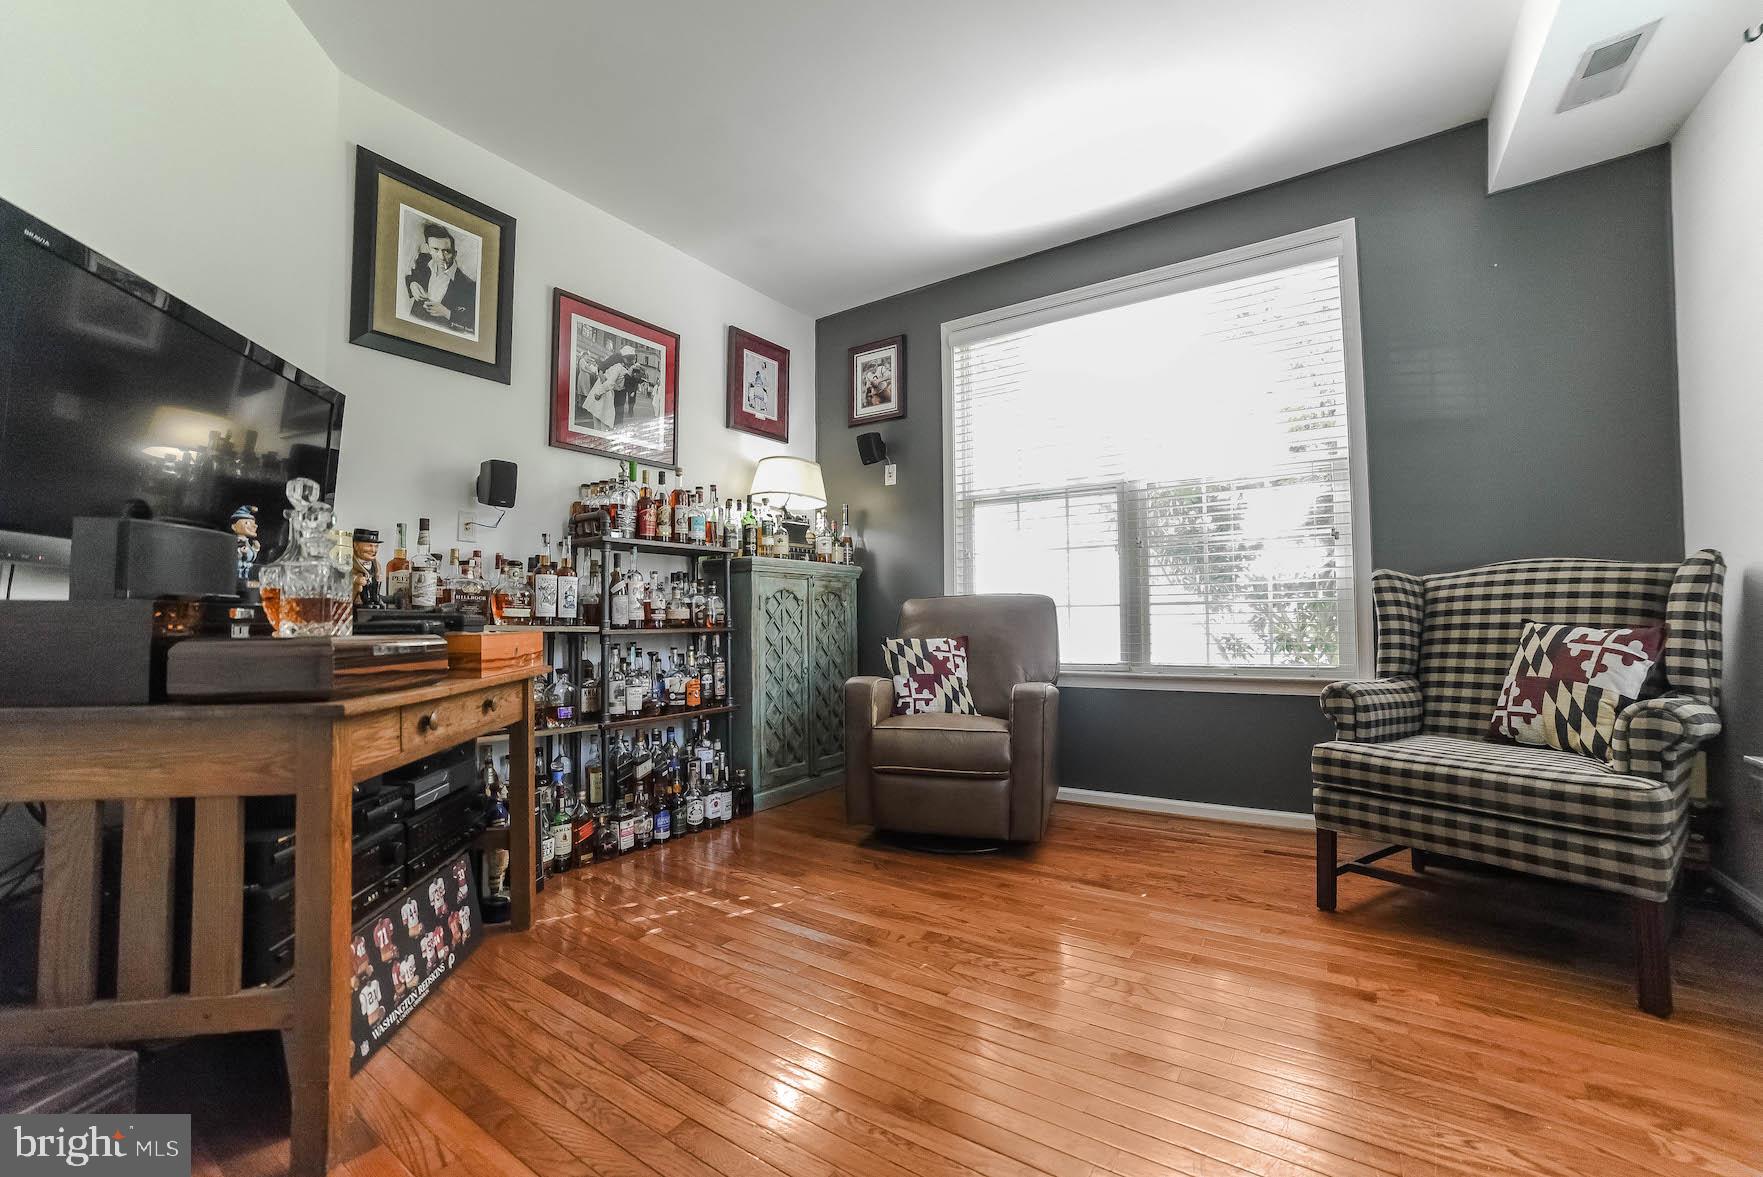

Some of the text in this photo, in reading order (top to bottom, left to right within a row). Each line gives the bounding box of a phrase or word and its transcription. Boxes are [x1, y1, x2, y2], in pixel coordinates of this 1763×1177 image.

[377, 927, 389, 949] 71
[368, 988, 379, 1006] 21
[371, 990, 419, 1040] WASHINGTON
[417, 962, 446, 996] REDSKINS
